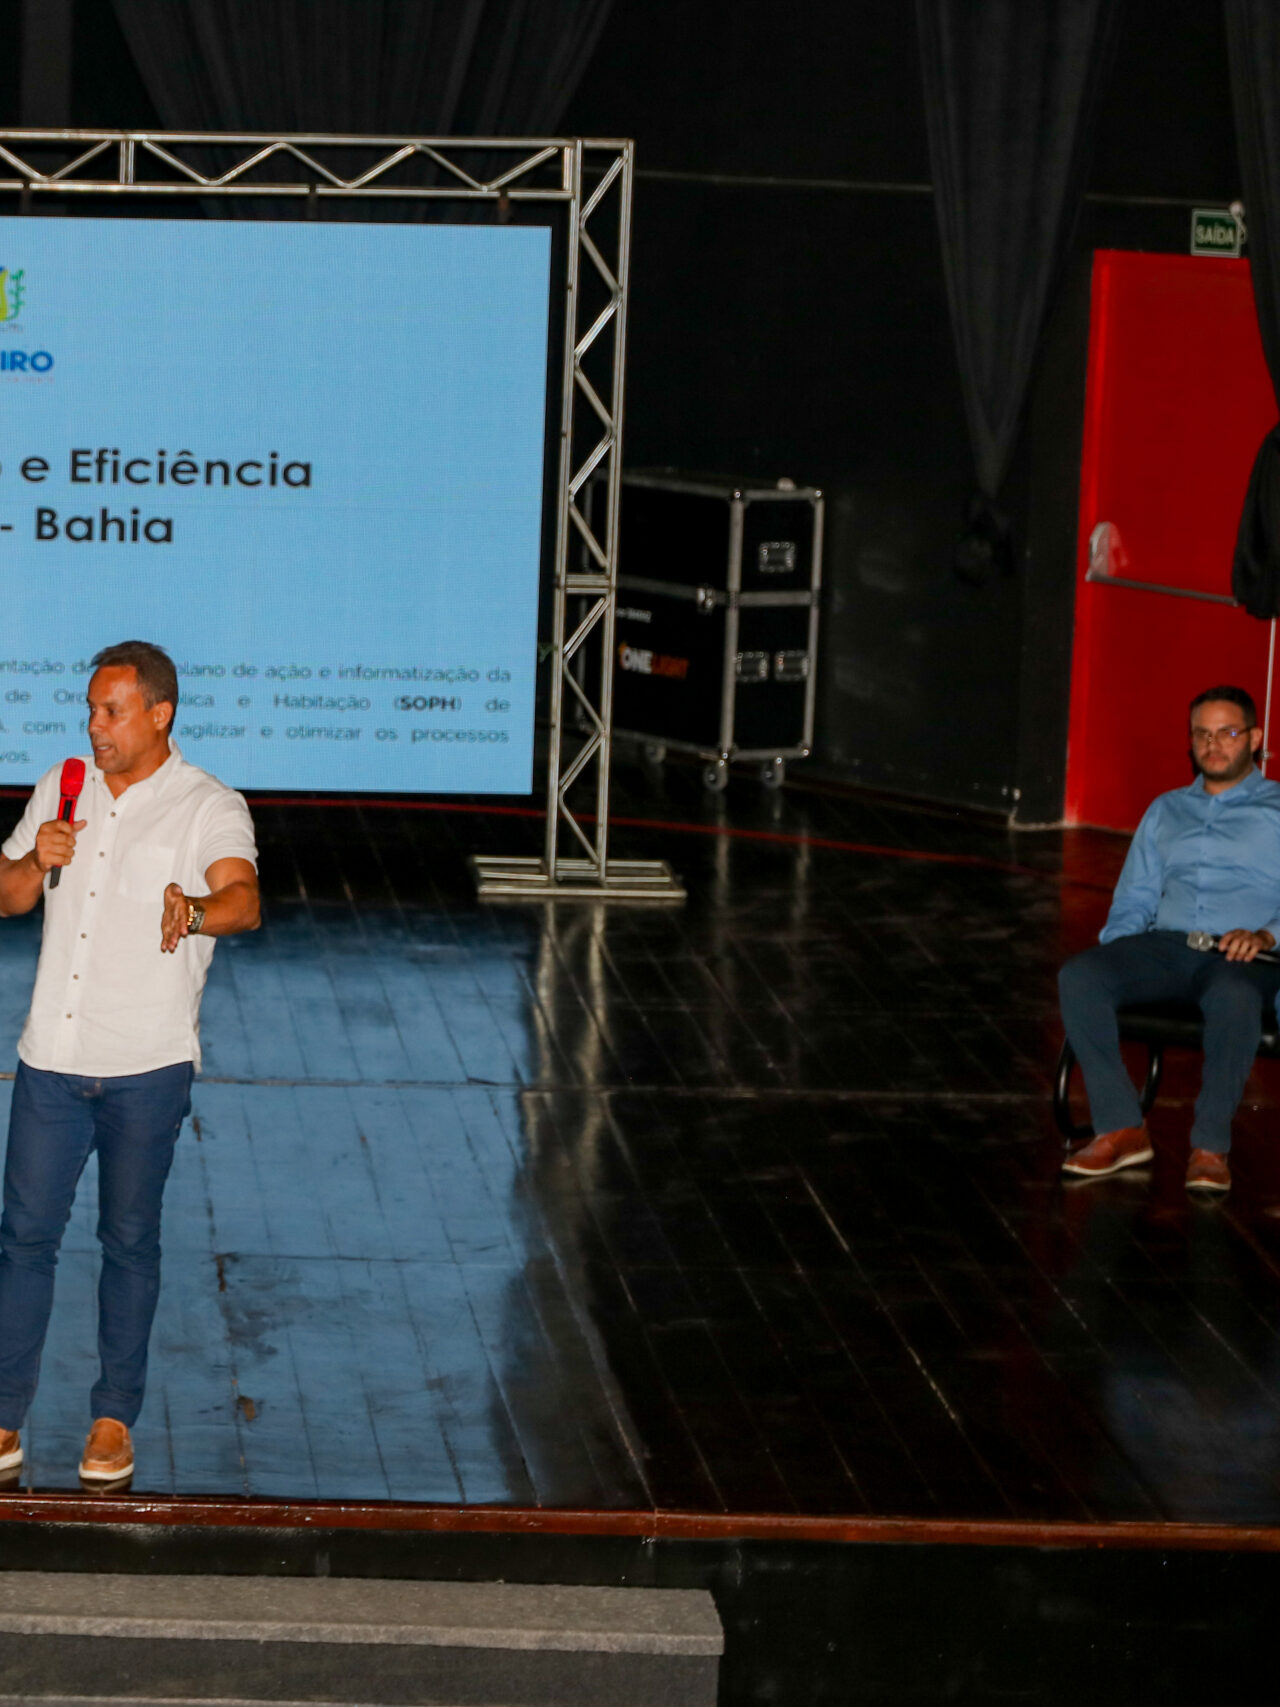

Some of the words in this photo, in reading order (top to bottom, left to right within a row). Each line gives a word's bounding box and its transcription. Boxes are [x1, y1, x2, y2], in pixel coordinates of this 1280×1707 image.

[1196, 221, 1234, 245] SAÍDA
[20, 456, 51, 483] e
[70, 448, 314, 489] Eficiência
[35, 506, 175, 544] Bahia
[231, 662, 258, 678] de
[265, 663, 313, 680] ação
[319, 667, 332, 679] e
[338, 664, 480, 684] informatização
[486, 667, 512, 682] da
[5, 688, 32, 703] de
[237, 695, 251, 708] e
[273, 694, 371, 711] Habitação
[394, 695, 462, 712] (SOPH)
[485, 697, 511, 712] de
[23, 719, 67, 734] com
[180, 722, 246, 741] agilizar
[260, 726, 273, 739] e
[286, 724, 361, 740] otimizar
[374, 728, 399, 742] os
[411, 728, 510, 743] processos
